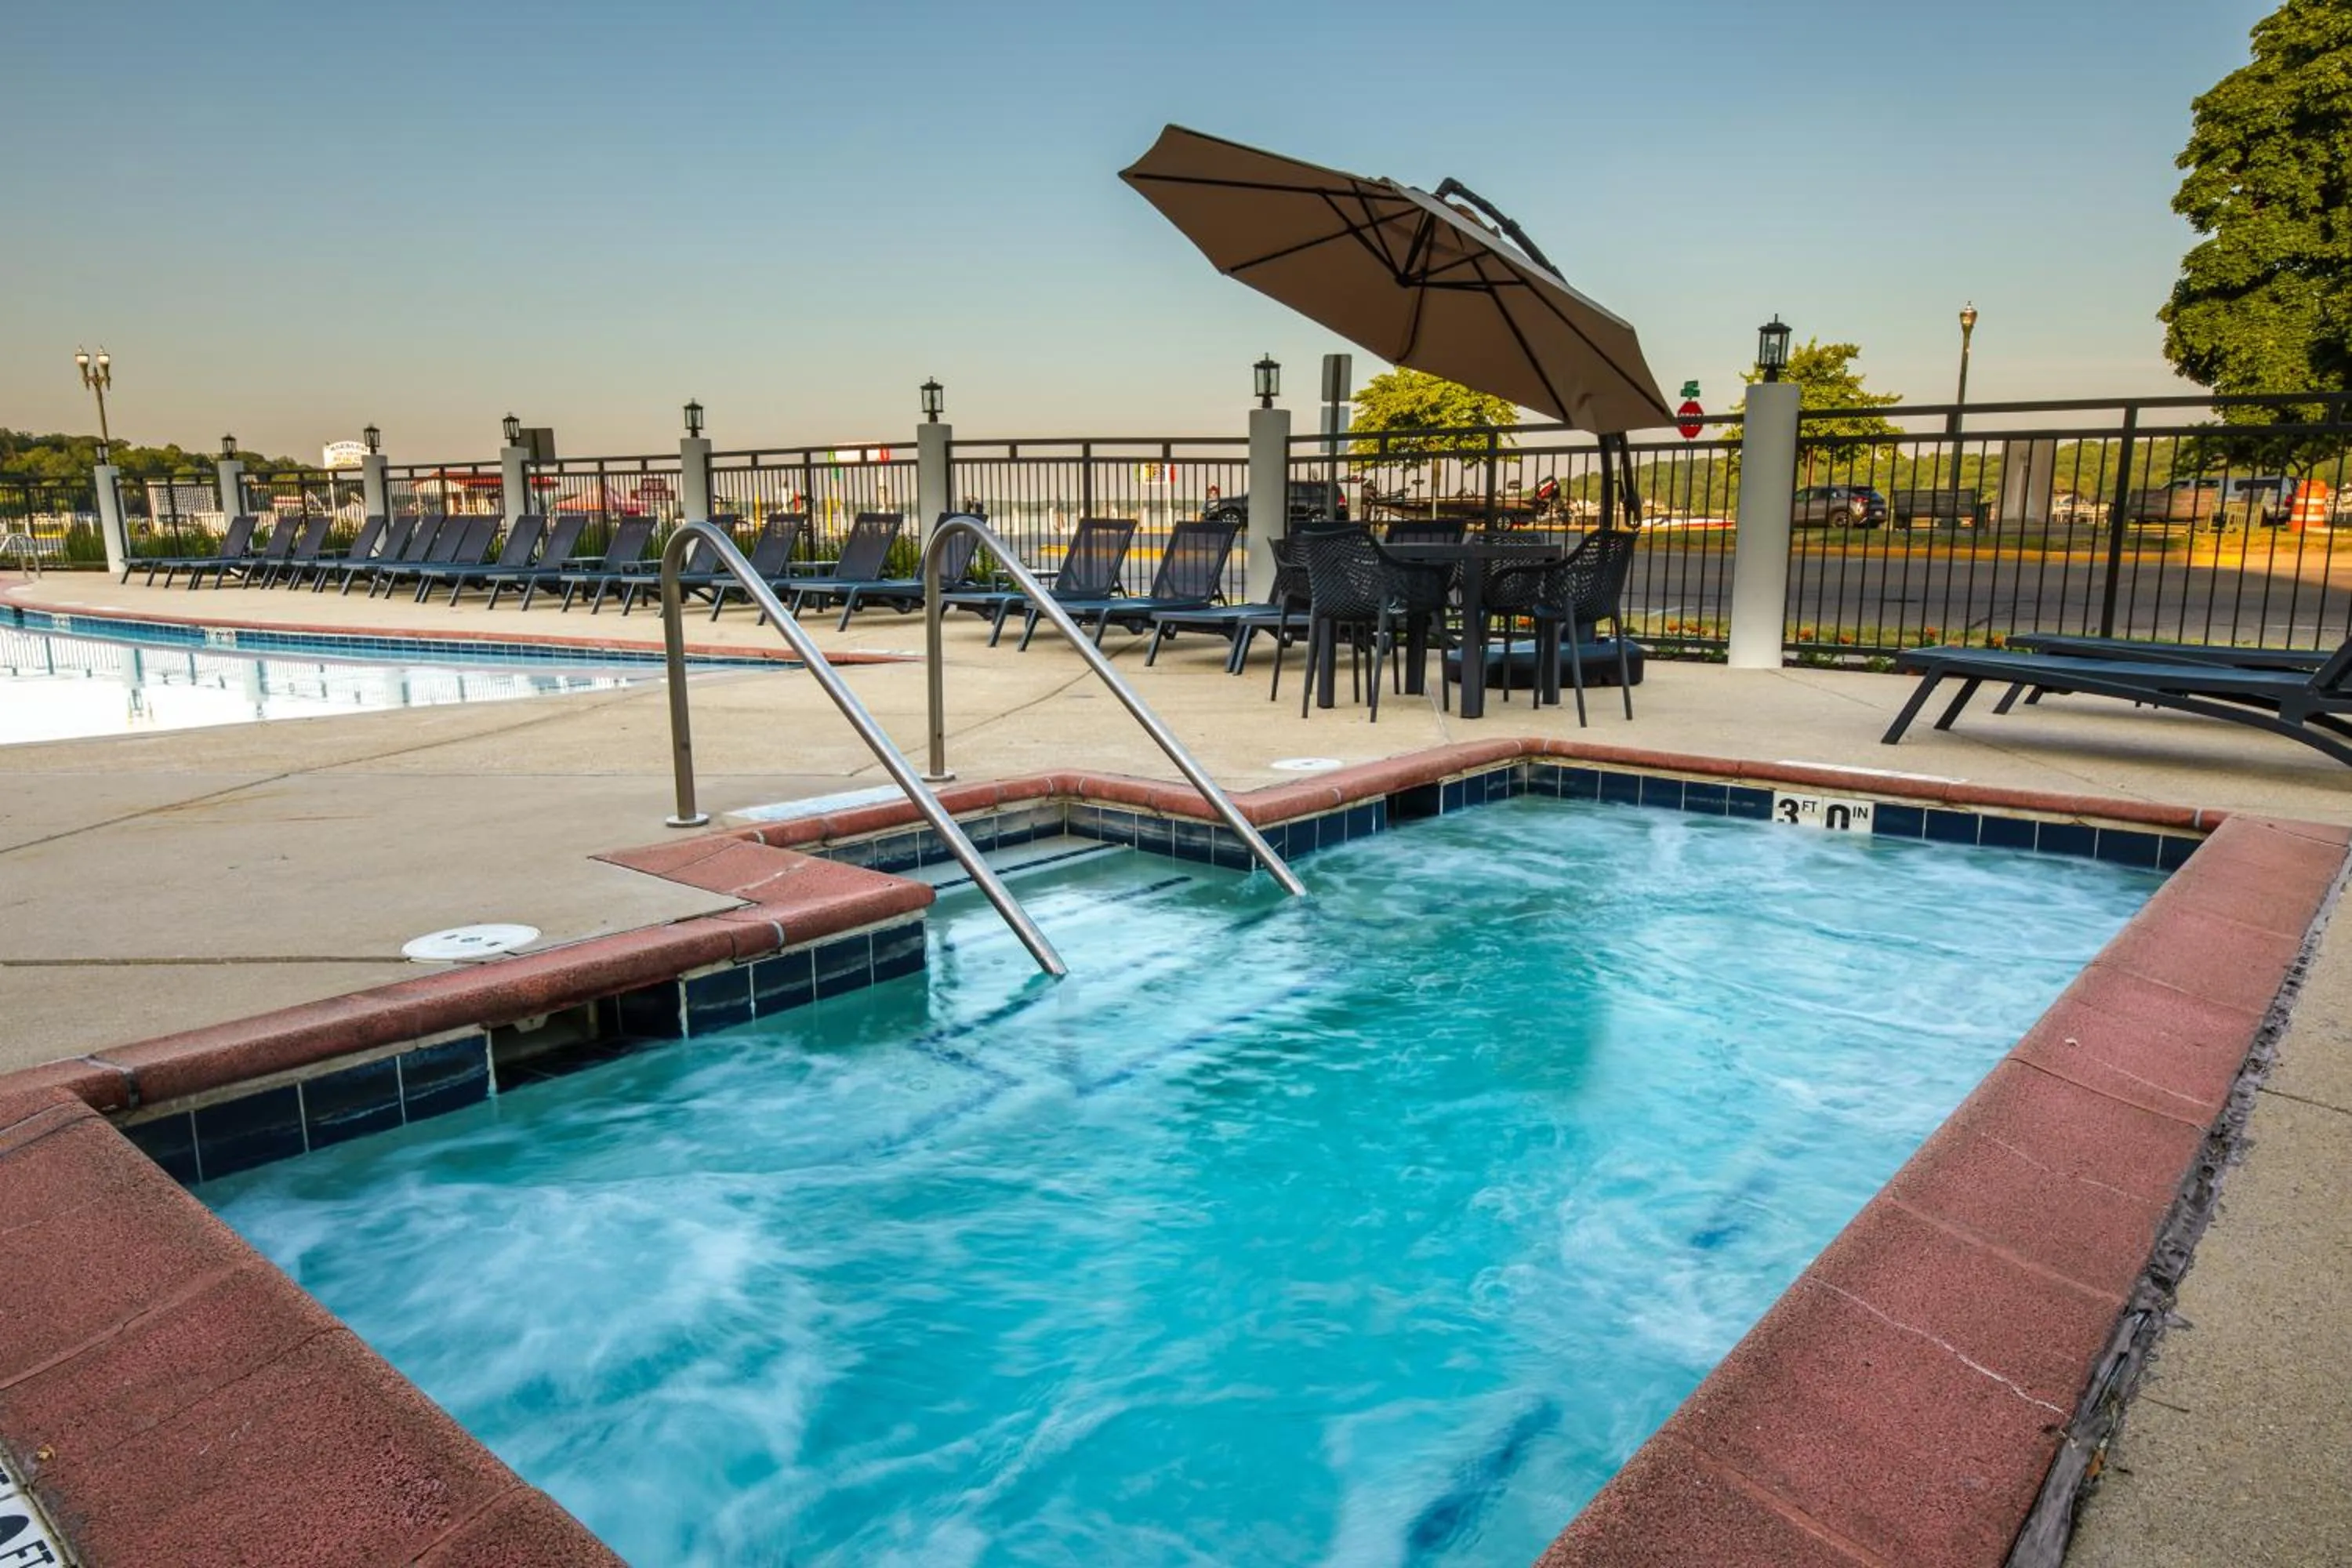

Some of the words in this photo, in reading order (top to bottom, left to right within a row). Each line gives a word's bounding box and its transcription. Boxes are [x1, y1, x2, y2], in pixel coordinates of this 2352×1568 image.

[1778, 798, 1799, 824] 3
[1802, 800, 1817, 813] FT
[1853, 805, 1869, 819] IN
